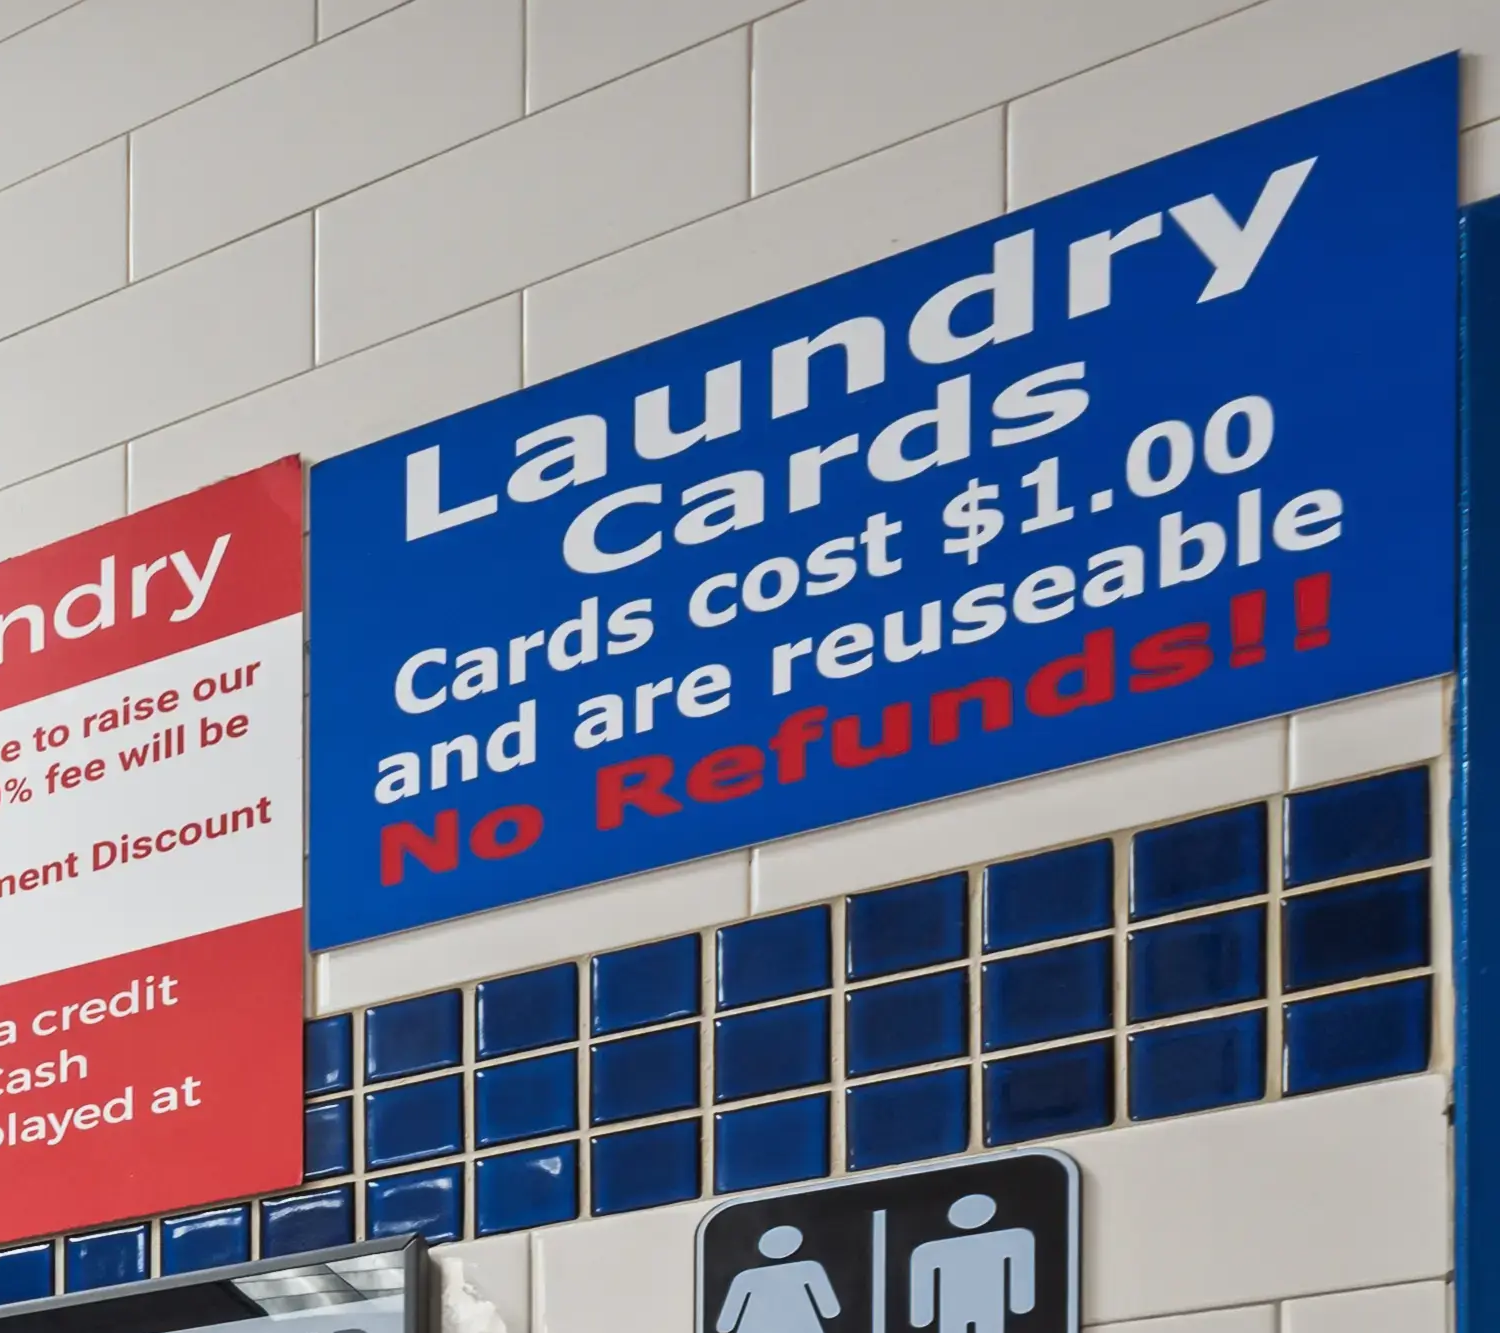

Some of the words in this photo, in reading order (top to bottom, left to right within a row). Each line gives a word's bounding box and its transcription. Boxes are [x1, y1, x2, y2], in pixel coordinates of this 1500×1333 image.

[405, 155, 1318, 543] Laundry
[562, 360, 1090, 576] Cards
[373, 701, 538, 807] and
[573, 661, 731, 750] are
[769, 485, 1344, 696] reuseable
[394, 595, 654, 717] Cards
[687, 507, 903, 629] cost
[941, 393, 1276, 565] $1.00
[379, 802, 544, 887] No
[595, 571, 1334, 832] Refunds!!
